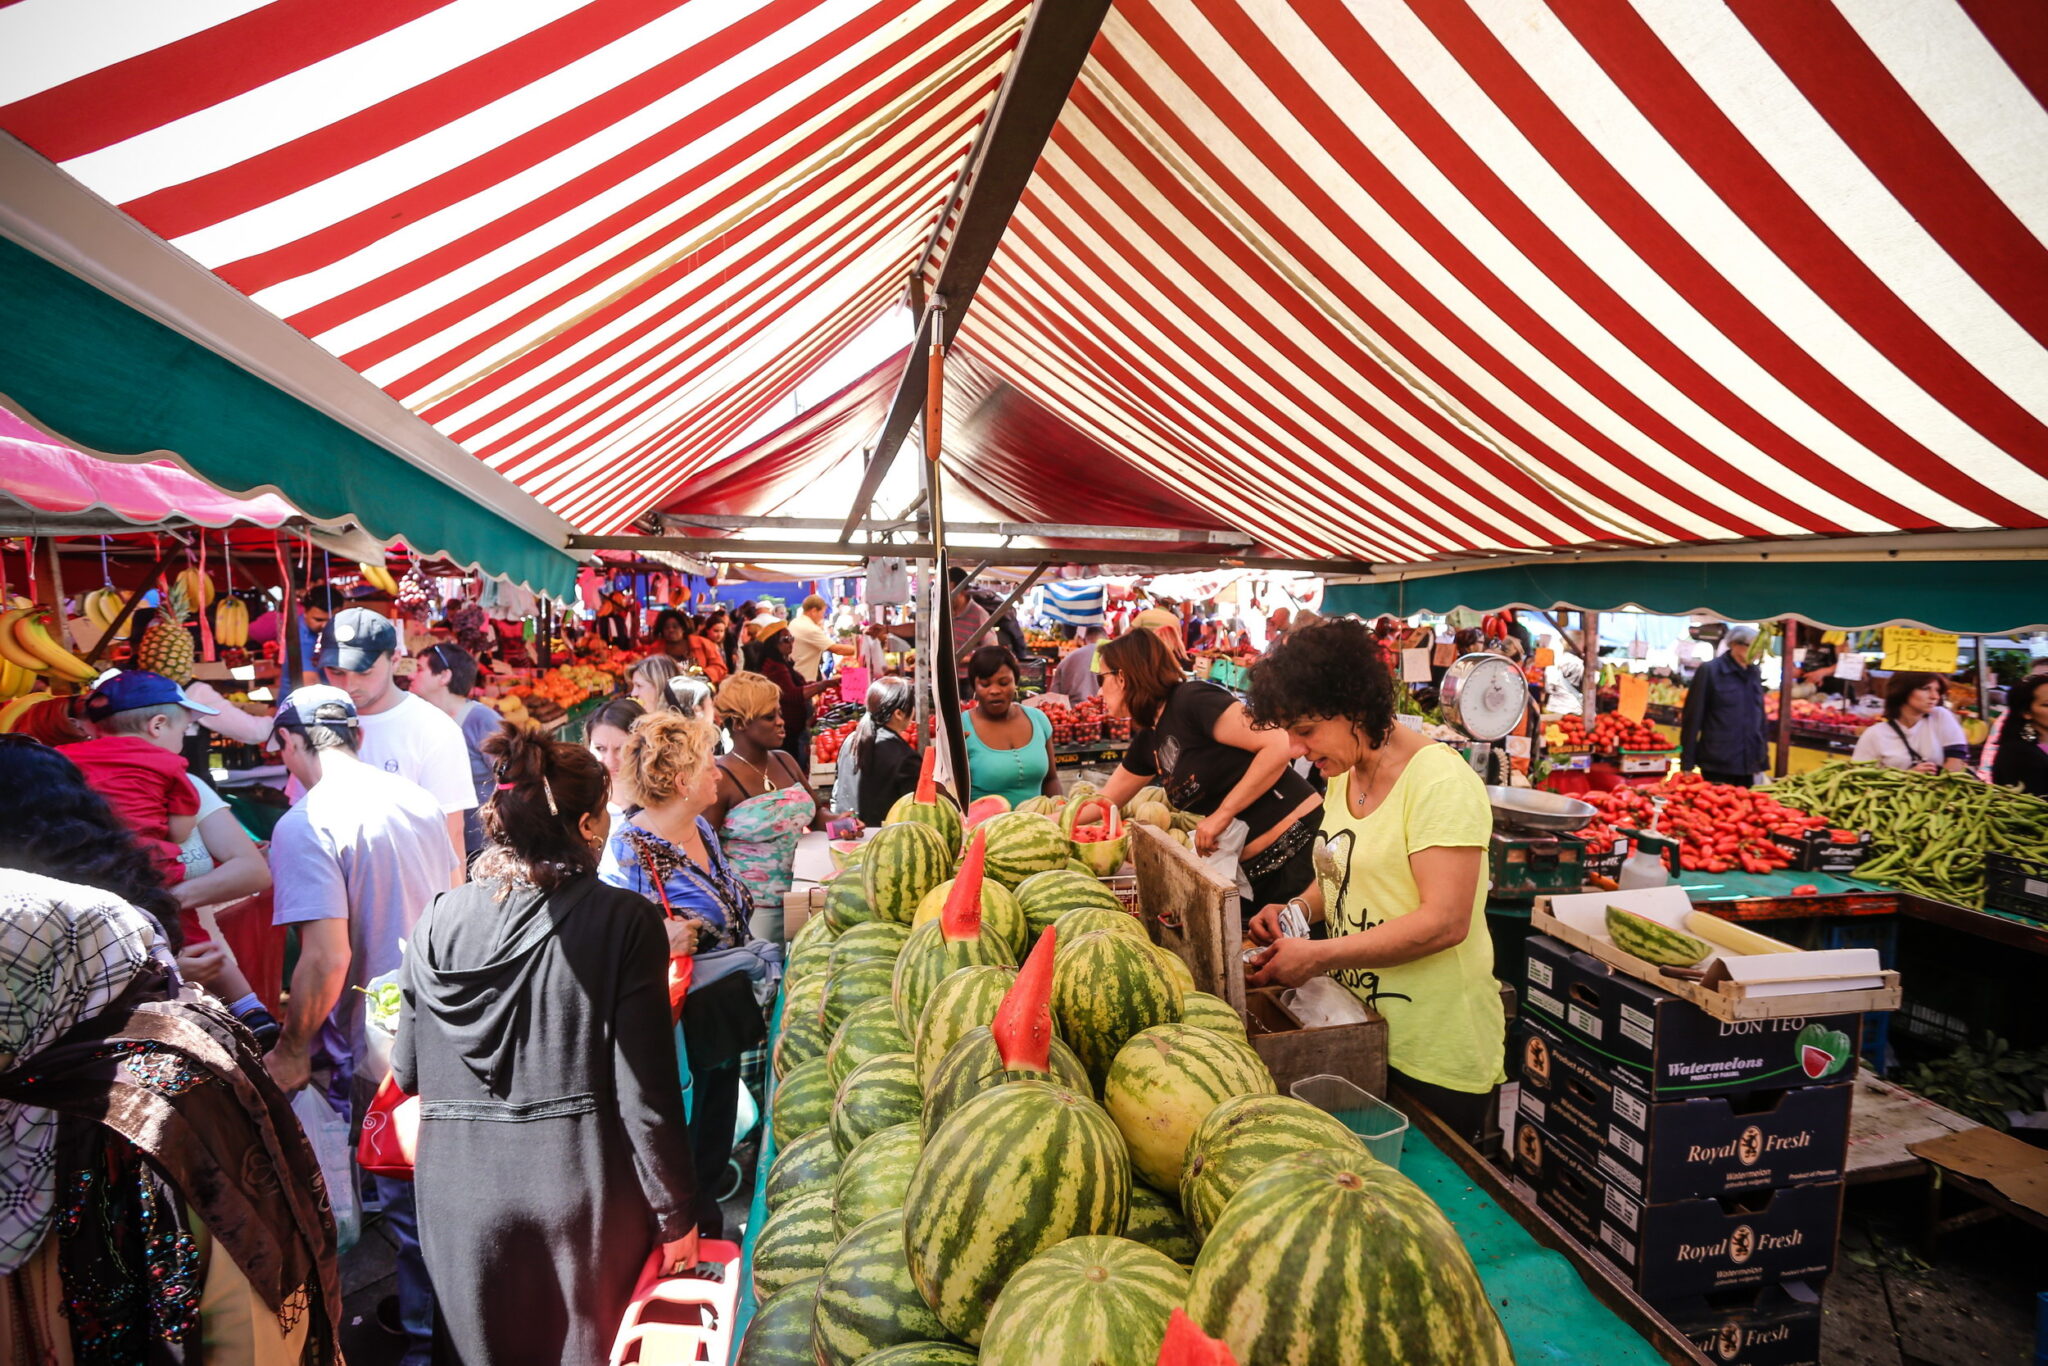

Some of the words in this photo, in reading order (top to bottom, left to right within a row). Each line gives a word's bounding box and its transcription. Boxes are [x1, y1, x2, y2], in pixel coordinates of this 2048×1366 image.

[1720, 1020, 1763, 1037] DON
[1668, 1057, 1764, 1077] Watermelons
[1687, 1139, 1737, 1165] Royal
[1766, 1131, 1811, 1151] Fresh
[1677, 1239, 1727, 1262] Royal
[1757, 1229, 1803, 1250] Fresh
[1745, 1324, 1789, 1346] Fresh
